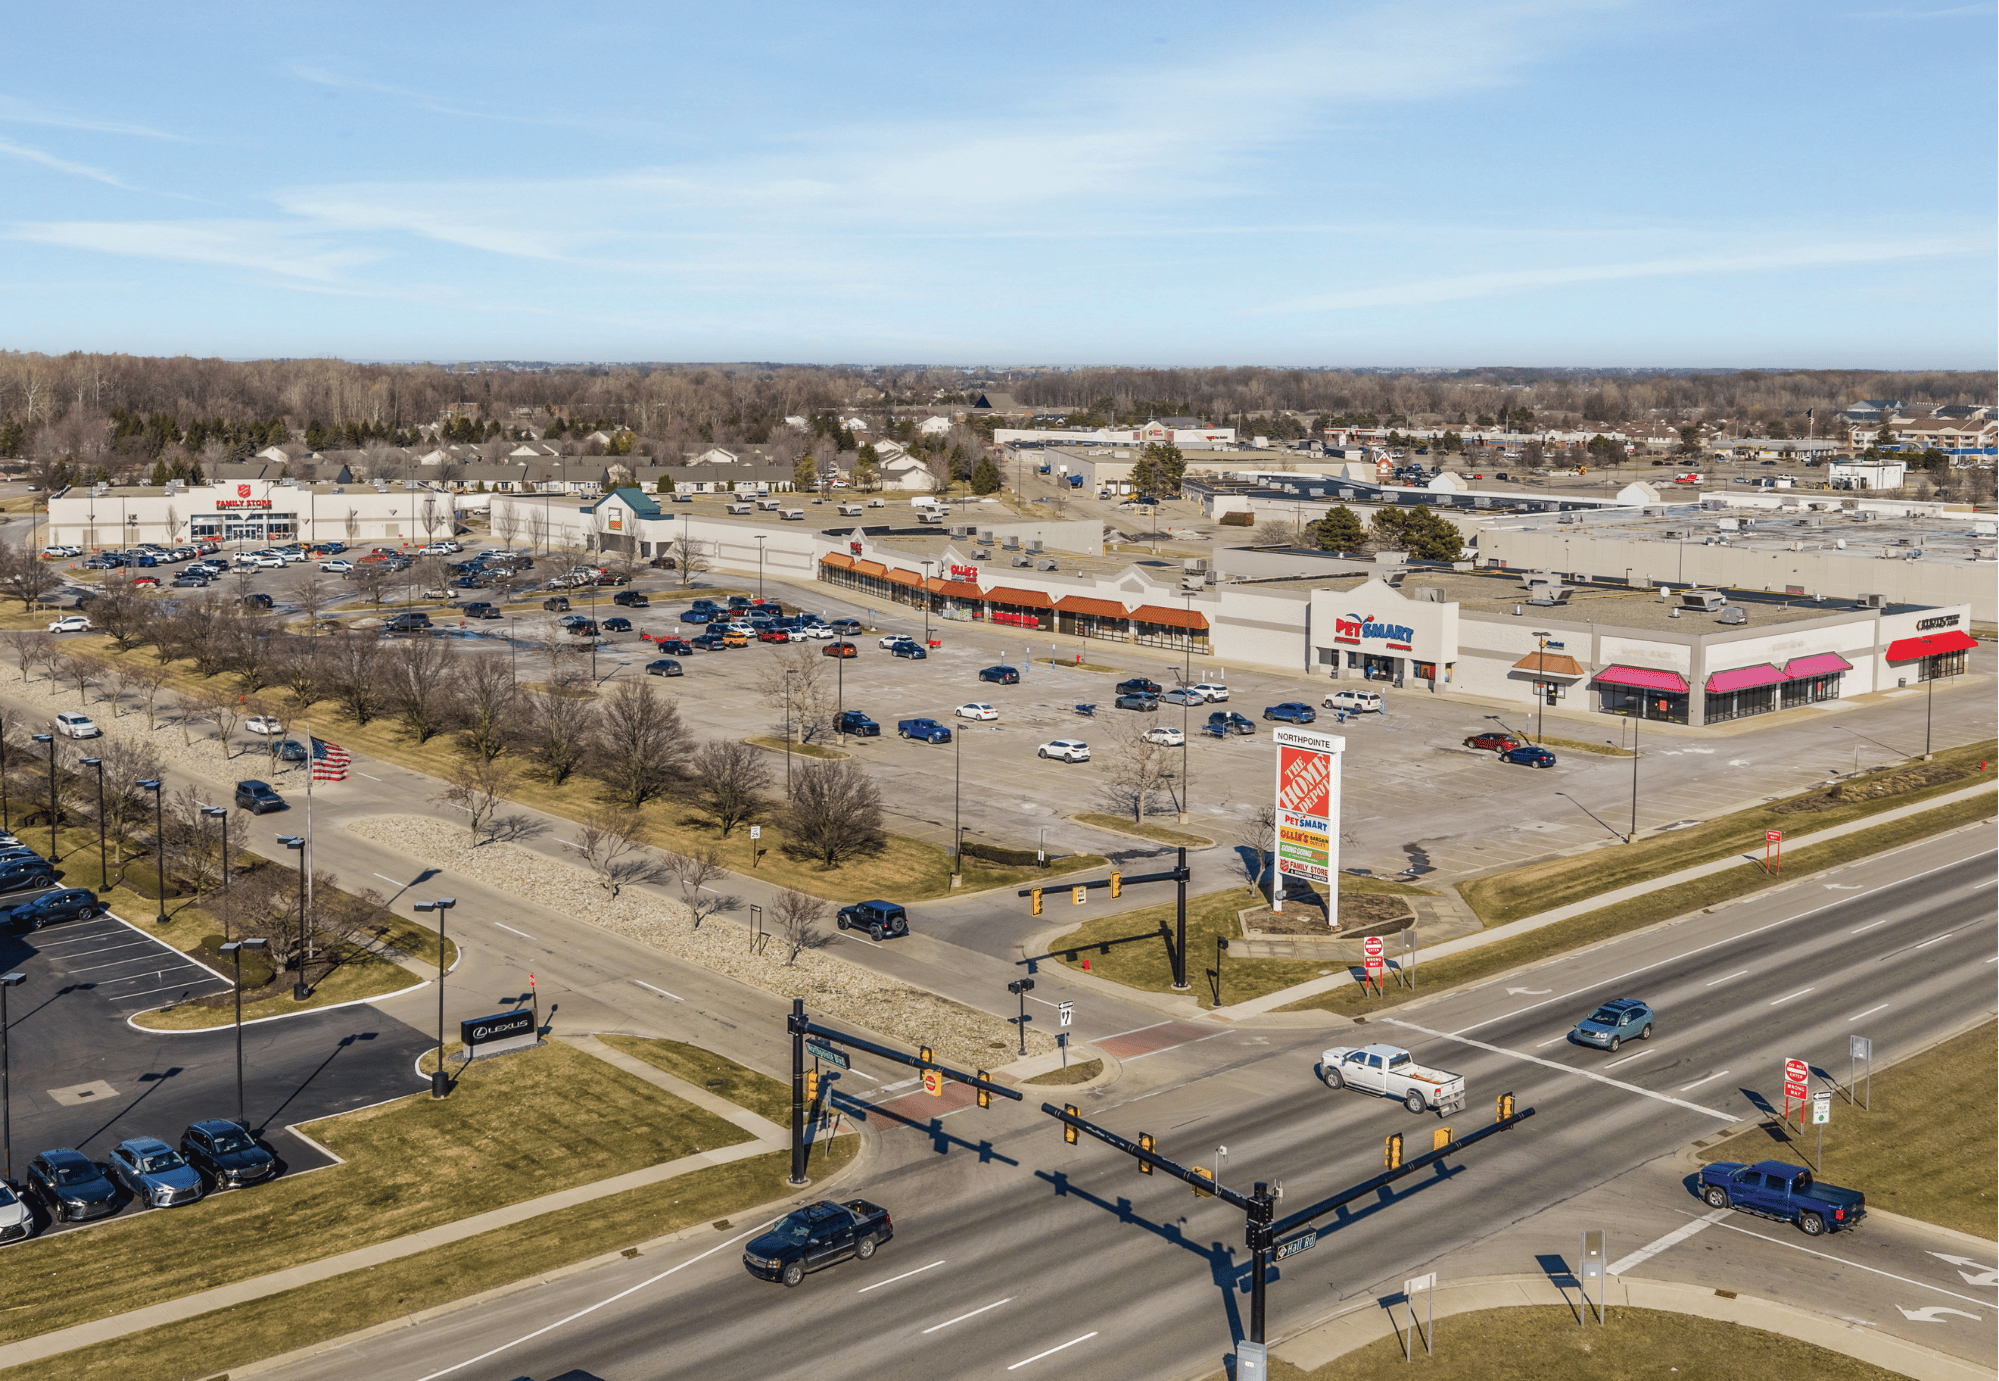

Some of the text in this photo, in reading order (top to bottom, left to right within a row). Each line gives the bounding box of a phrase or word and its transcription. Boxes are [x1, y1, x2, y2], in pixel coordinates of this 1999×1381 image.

[1336, 618, 1414, 643] PETSMART
[1278, 732, 1330, 748] NORTHPOINTE
[1284, 756, 1306, 780] THE
[1280, 753, 1330, 810] HOME
[1298, 777, 1330, 813] DEPOT
[1285, 814, 1328, 832] PETSMART
[1290, 861, 1308, 872] FAMILY
[1310, 866, 1328, 876] STORE
[488, 1020, 528, 1034] LEXUS
[1787, 1084, 1804, 1092] WRONG
[1288, 1239, 1302, 1255] Hall
[1304, 1234, 1314, 1248] Rd
